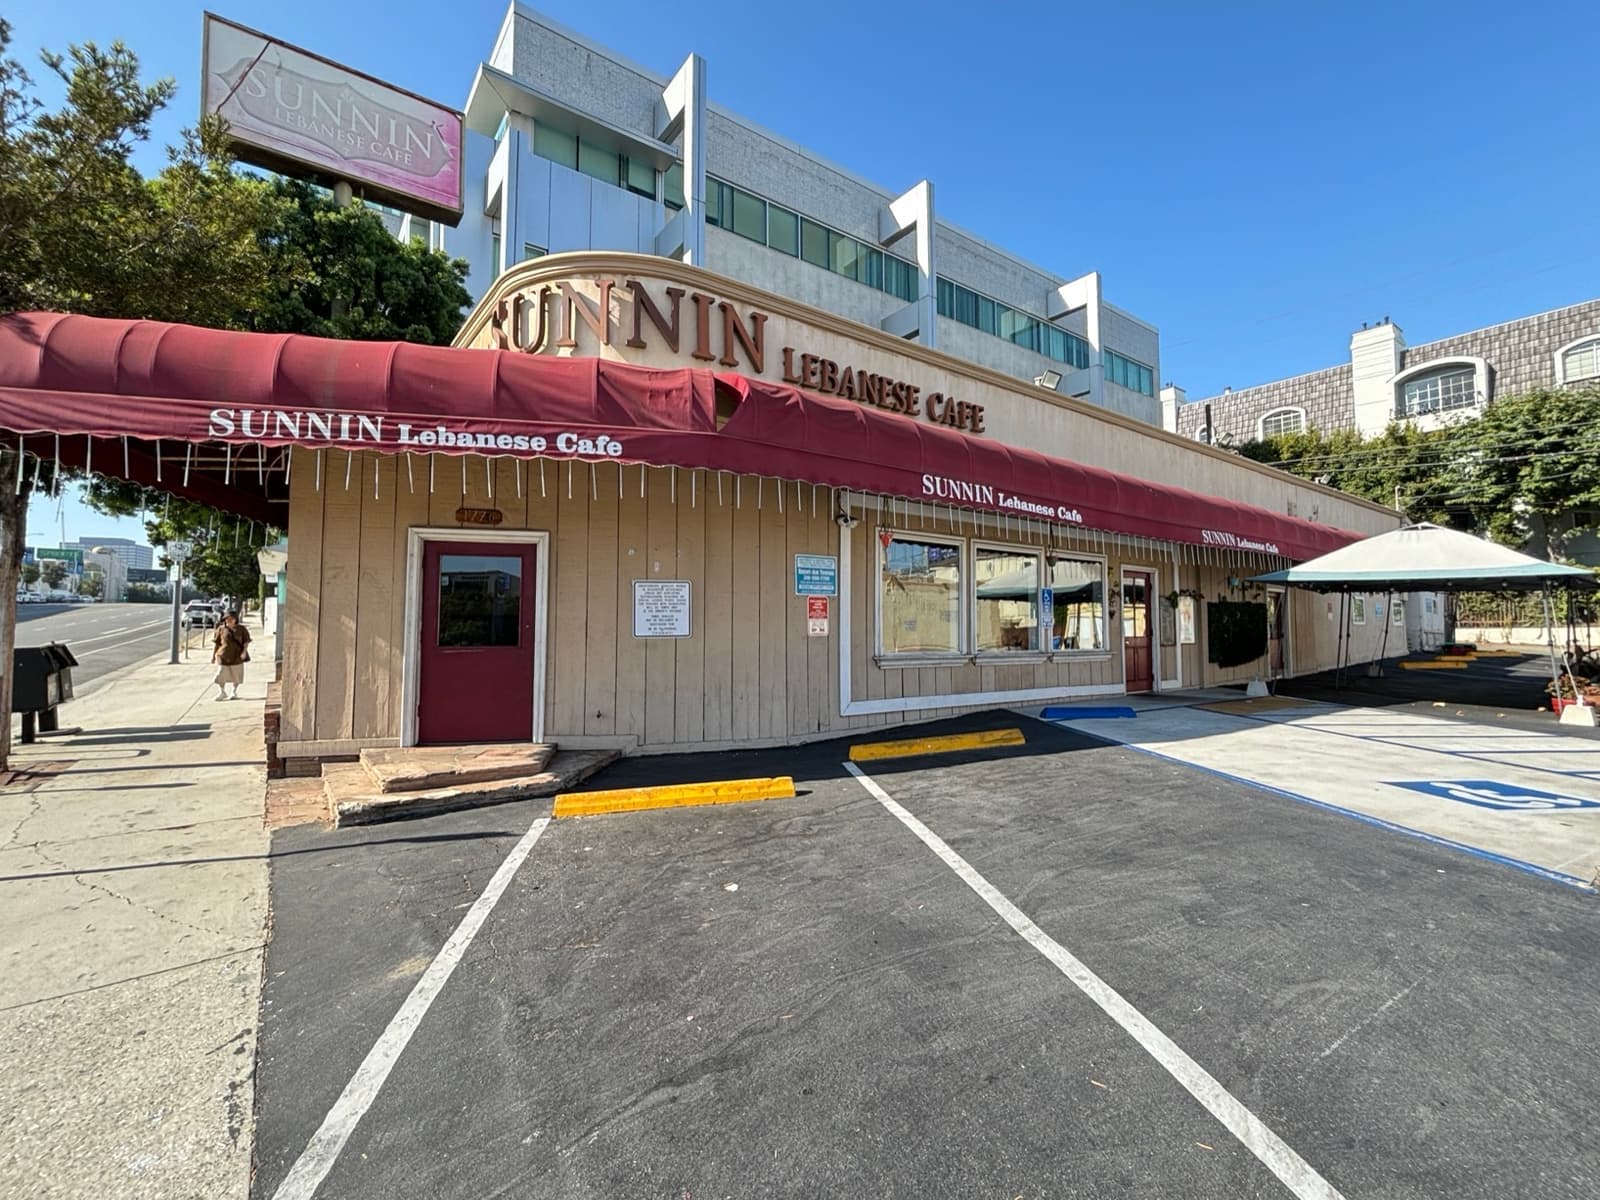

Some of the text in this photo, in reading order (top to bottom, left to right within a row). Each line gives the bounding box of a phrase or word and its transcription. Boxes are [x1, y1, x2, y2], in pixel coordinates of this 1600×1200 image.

[246, 67, 434, 159] SUNNIN
[275, 108, 412, 166] LEBANESE CAFE
[782, 346, 920, 416] LEBANESE
[926, 392, 985, 433] CAFE
[208, 409, 623, 457] SUNNIN Lebanese Cafe
[922, 473, 1083, 523] SUNNIN Lebanese Cafe
[1201, 529, 1236, 546] SUNNIN
